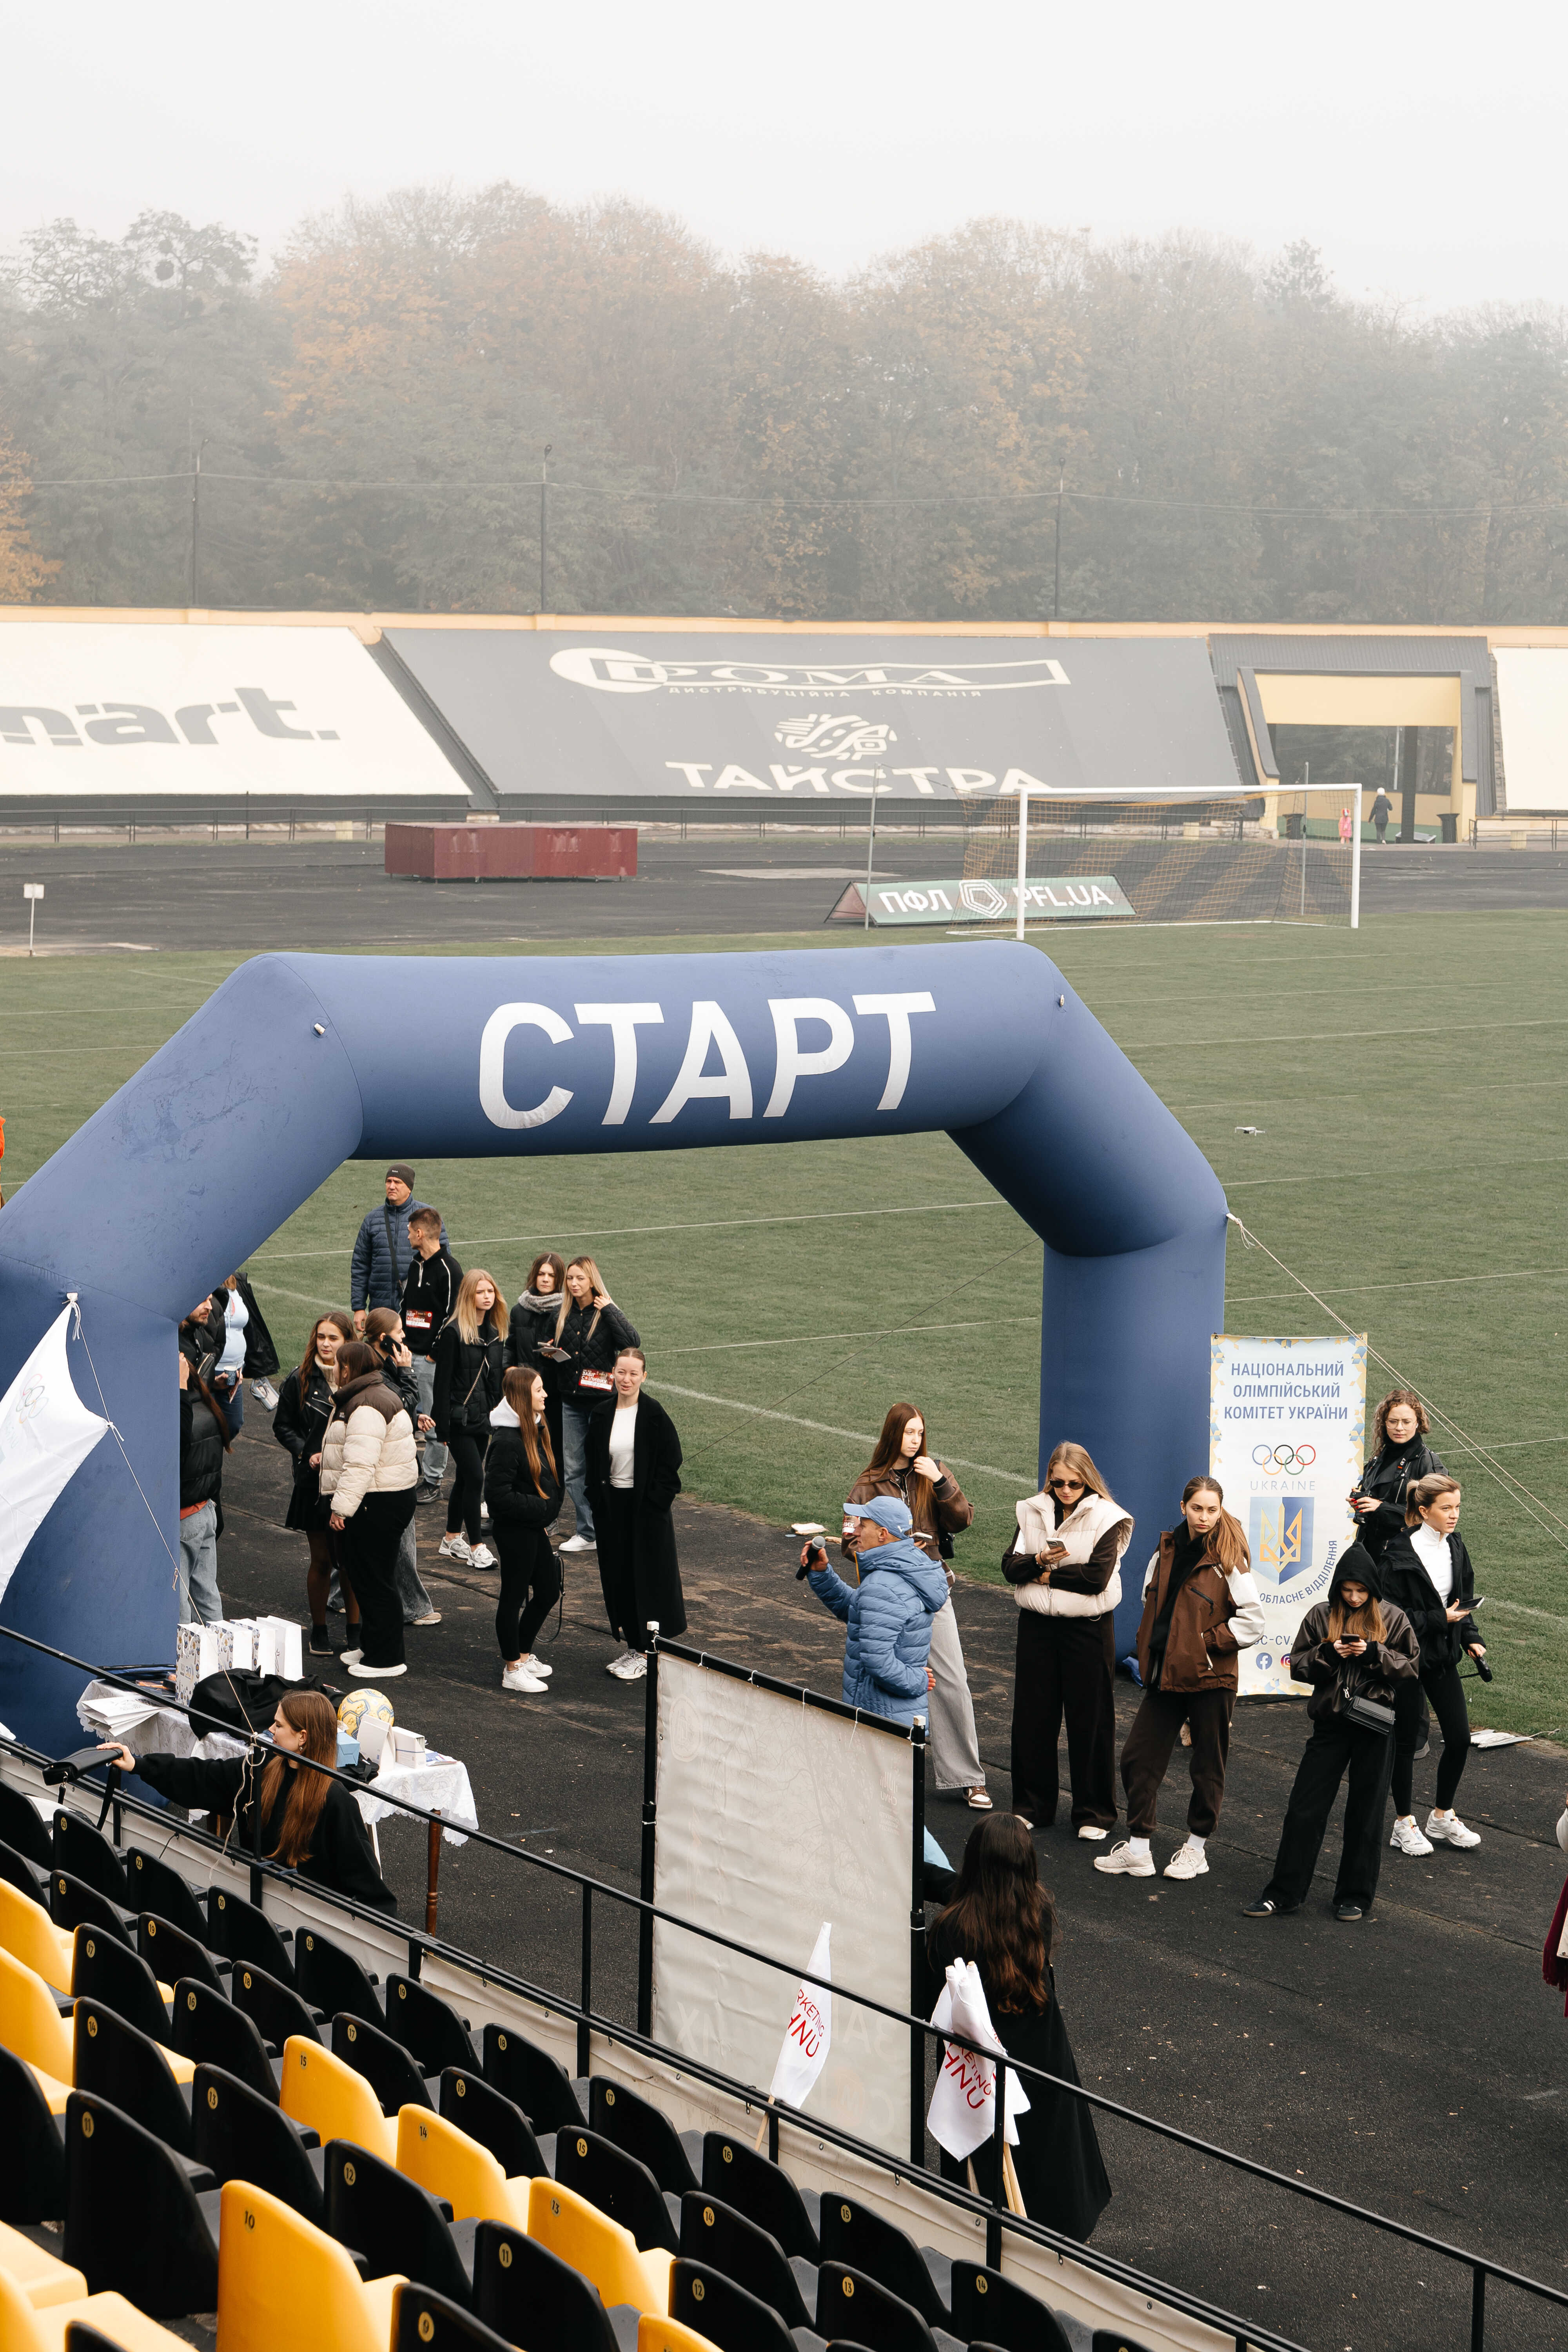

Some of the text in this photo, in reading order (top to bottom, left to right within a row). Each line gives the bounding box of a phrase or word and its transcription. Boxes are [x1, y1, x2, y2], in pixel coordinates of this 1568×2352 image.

[669, 687, 982, 697] ДИСТРИБУЦІЙНА КОМПАНІЯ
[665, 761, 1054, 794] ТАЙСТРА
[878, 889, 953, 913] ПФЛ
[1012, 885, 1115, 907] PFL.UA
[479, 991, 936, 1129] СТАРТ
[1231, 1361, 1344, 1378] НАЦІОНАЛЬНИЙ
[1233, 1382, 1340, 1397] ОЛІМПІЙСЬКИЙ
[1224, 1404, 1348, 1419] КОМІТЕТ УКРАЇНИ
[1250, 1481, 1316, 1491] UKRAINE
[1260, 1540, 1337, 1604] ОБЛАСНЕ ВІДДІЛЕННЯ
[149, 1924, 154, 1933] 19
[88, 1944, 94, 1955] 17
[245, 1976, 250, 1986] 18
[400, 1988, 405, 1996] 19
[189, 1996, 195, 2007] 16
[89, 2021, 96, 2033] 14
[349, 2029, 355, 2038] 17
[500, 2038, 506, 2048] 18
[300, 2055, 307, 2066] 15
[457, 2083, 464, 2093] 16
[209, 2092, 216, 2105] 13
[607, 2092, 613, 2102] 17
[420, 2126, 427, 2138] 14
[579, 2142, 585, 2154] 15
[724, 2150, 731, 2160] 16
[347, 2167, 353, 2181] 12
[552, 2200, 559, 2214] 13
[705, 2211, 712, 2223] 14
[842, 2209, 849, 2219] 15
[245, 2211, 255, 2230] 10
[502, 2249, 508, 2263] 11
[695, 2283, 702, 2297] 12
[845, 2282, 852, 2293] 13
[978, 2279, 985, 2290] 14
[423, 2319, 429, 2334] 9
